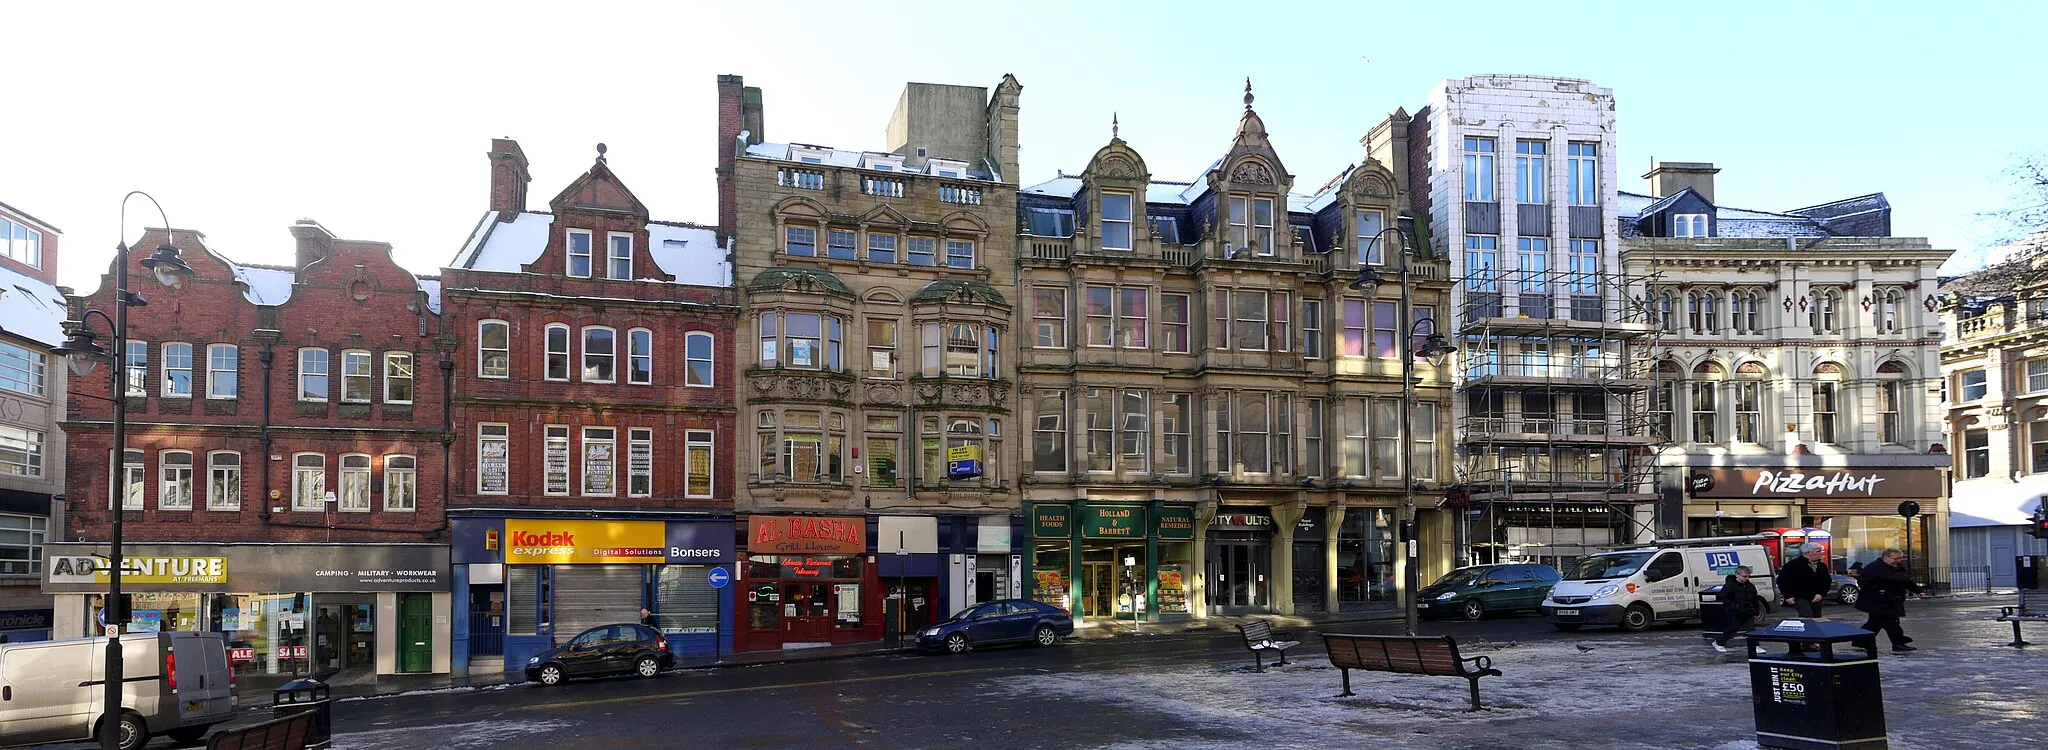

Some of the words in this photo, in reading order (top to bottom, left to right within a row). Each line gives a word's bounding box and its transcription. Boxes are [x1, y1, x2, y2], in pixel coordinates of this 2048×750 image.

[1752, 470, 1826, 495] Pizza
[1820, 472, 1885, 496] Hut
[1100, 509, 1130, 518] HOLLAND
[1112, 518, 1118, 527] &
[756, 520, 782, 544] AL
[789, 518, 859, 545] BASHA
[1100, 527, 1131, 535] BARRETT
[1664, 528, 1675, 536] 19
[513, 530, 575, 546] Kodak
[513, 547, 575, 556] express
[593, 548, 621, 556] Digital
[624, 548, 662, 556] Solutions
[670, 546, 721, 558] Bonsers
[775, 542, 801, 552] Grill
[805, 541, 841, 551] House
[806, 557, 833, 567] Restaurant
[1710, 553, 1738, 567] JBL
[52, 557, 224, 576] ADVENTURE
[1782, 682, 1805, 693] £50
[1773, 687, 1781, 703] JUST
